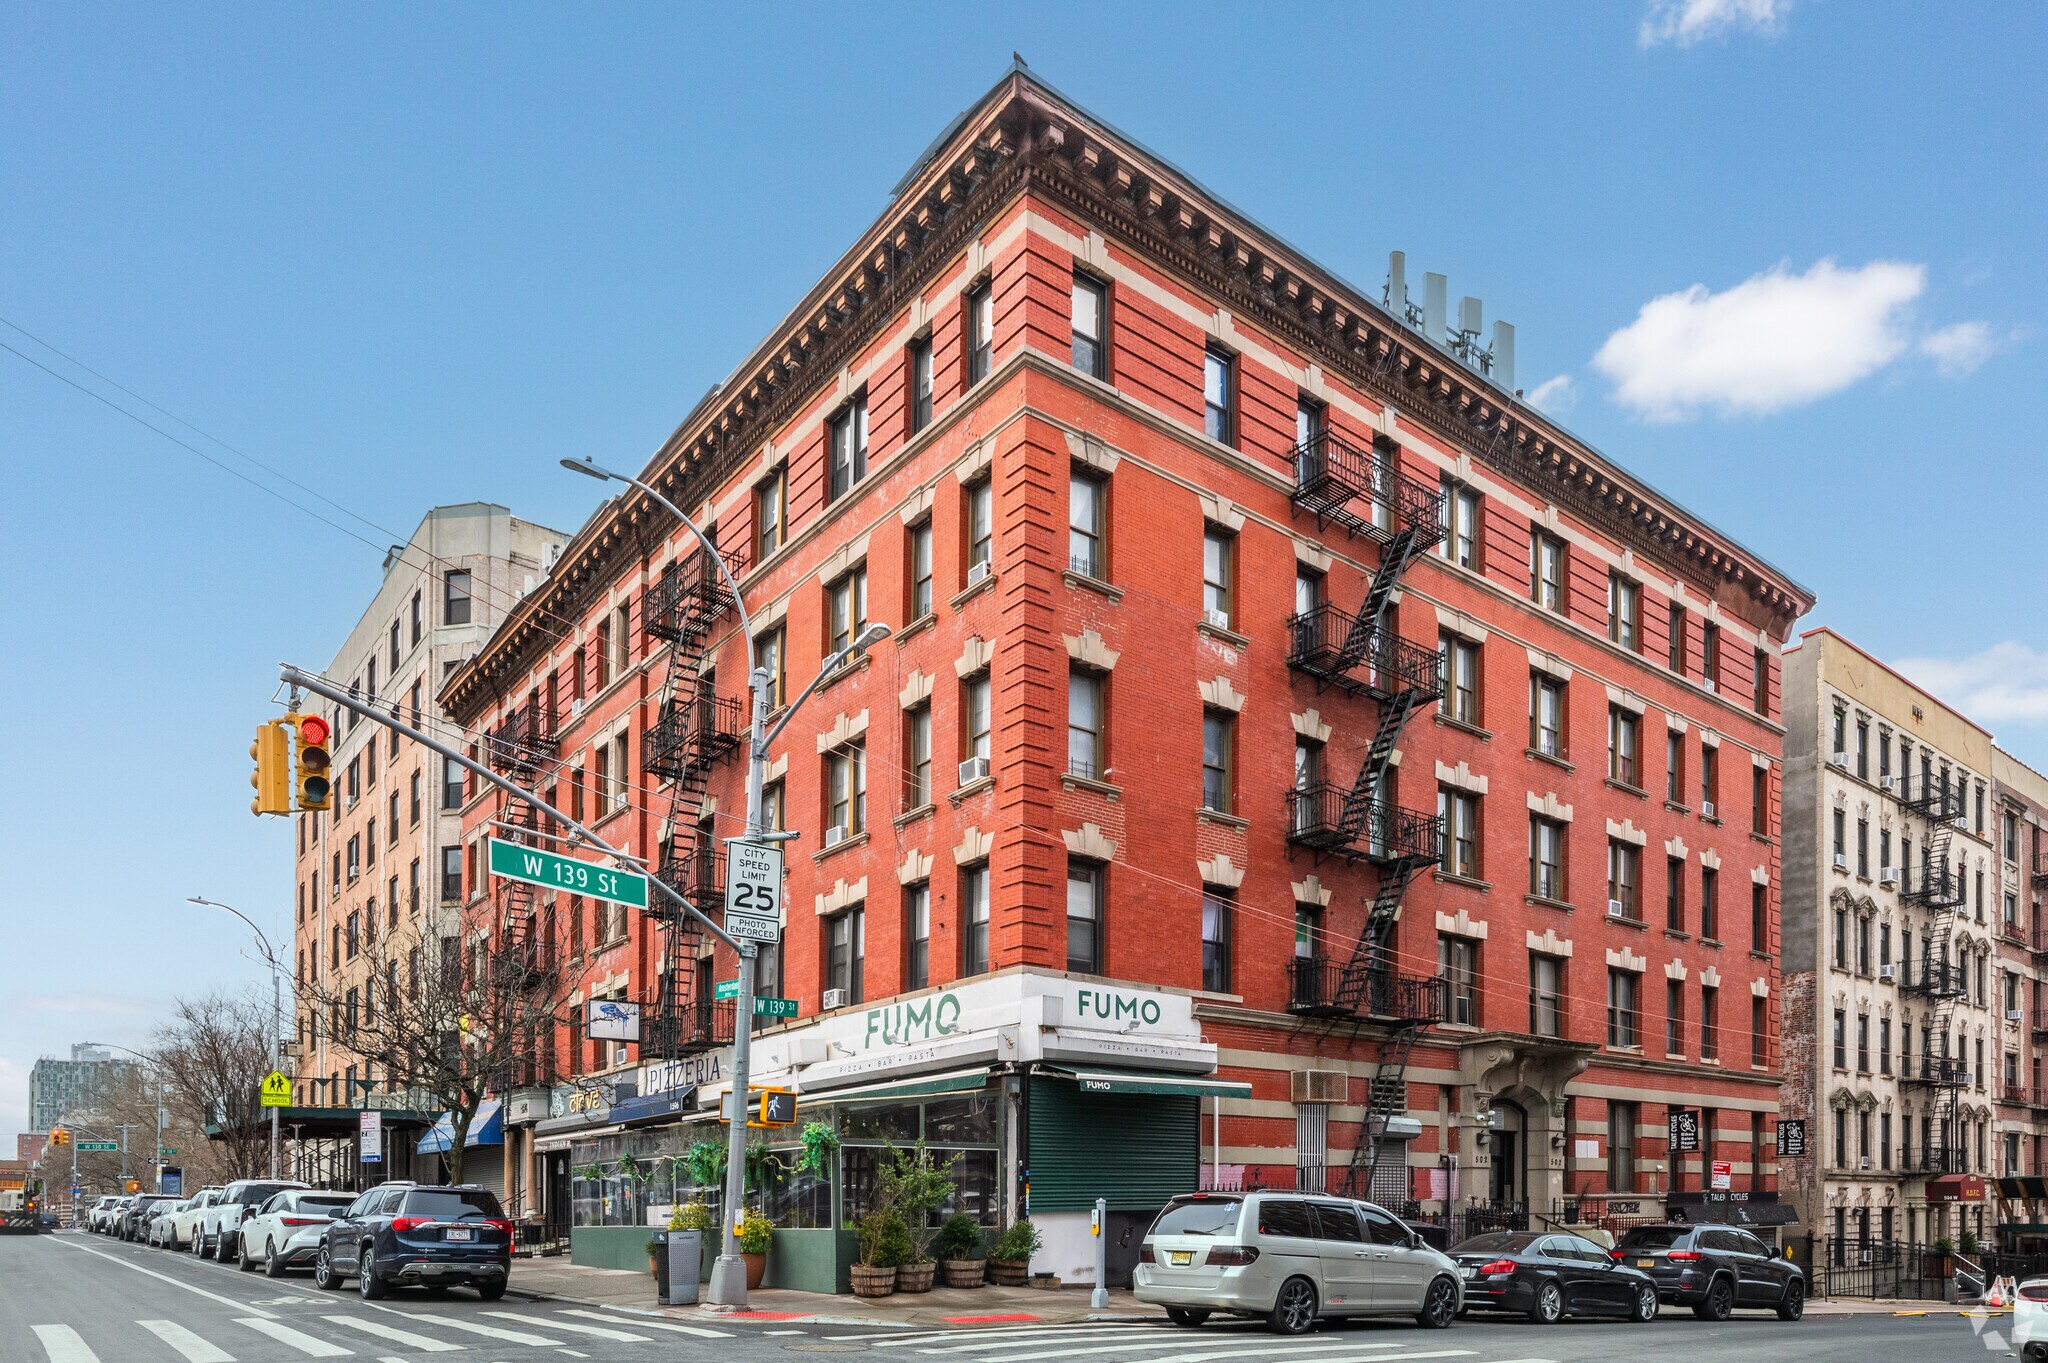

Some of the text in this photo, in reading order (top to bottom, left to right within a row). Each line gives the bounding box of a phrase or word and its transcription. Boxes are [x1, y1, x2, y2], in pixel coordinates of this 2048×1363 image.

[744, 848, 766, 859] CITY
[739, 859, 770, 871] SPEED
[523, 854, 618, 895] W 139 St
[741, 870, 767, 881] LIMIT
[734, 882, 774, 911] 25
[739, 918, 766, 929] PHOTO
[730, 926, 774, 938] ENFORCED
[757, 999, 795, 1014] W 139 St
[1078, 990, 1161, 1025] FUMO
[864, 993, 961, 1049] FUMO
[839, 1052, 935, 1073] PIZZA BAR PASTA
[650, 1056, 720, 1092] PIZZERIA
[1086, 1080, 1111, 1090] FUMO
[1475, 1155, 1488, 1163] 502
[1550, 1158, 1562, 1166] 502
[1711, 1192, 1749, 1201] TALEN CYCLES
